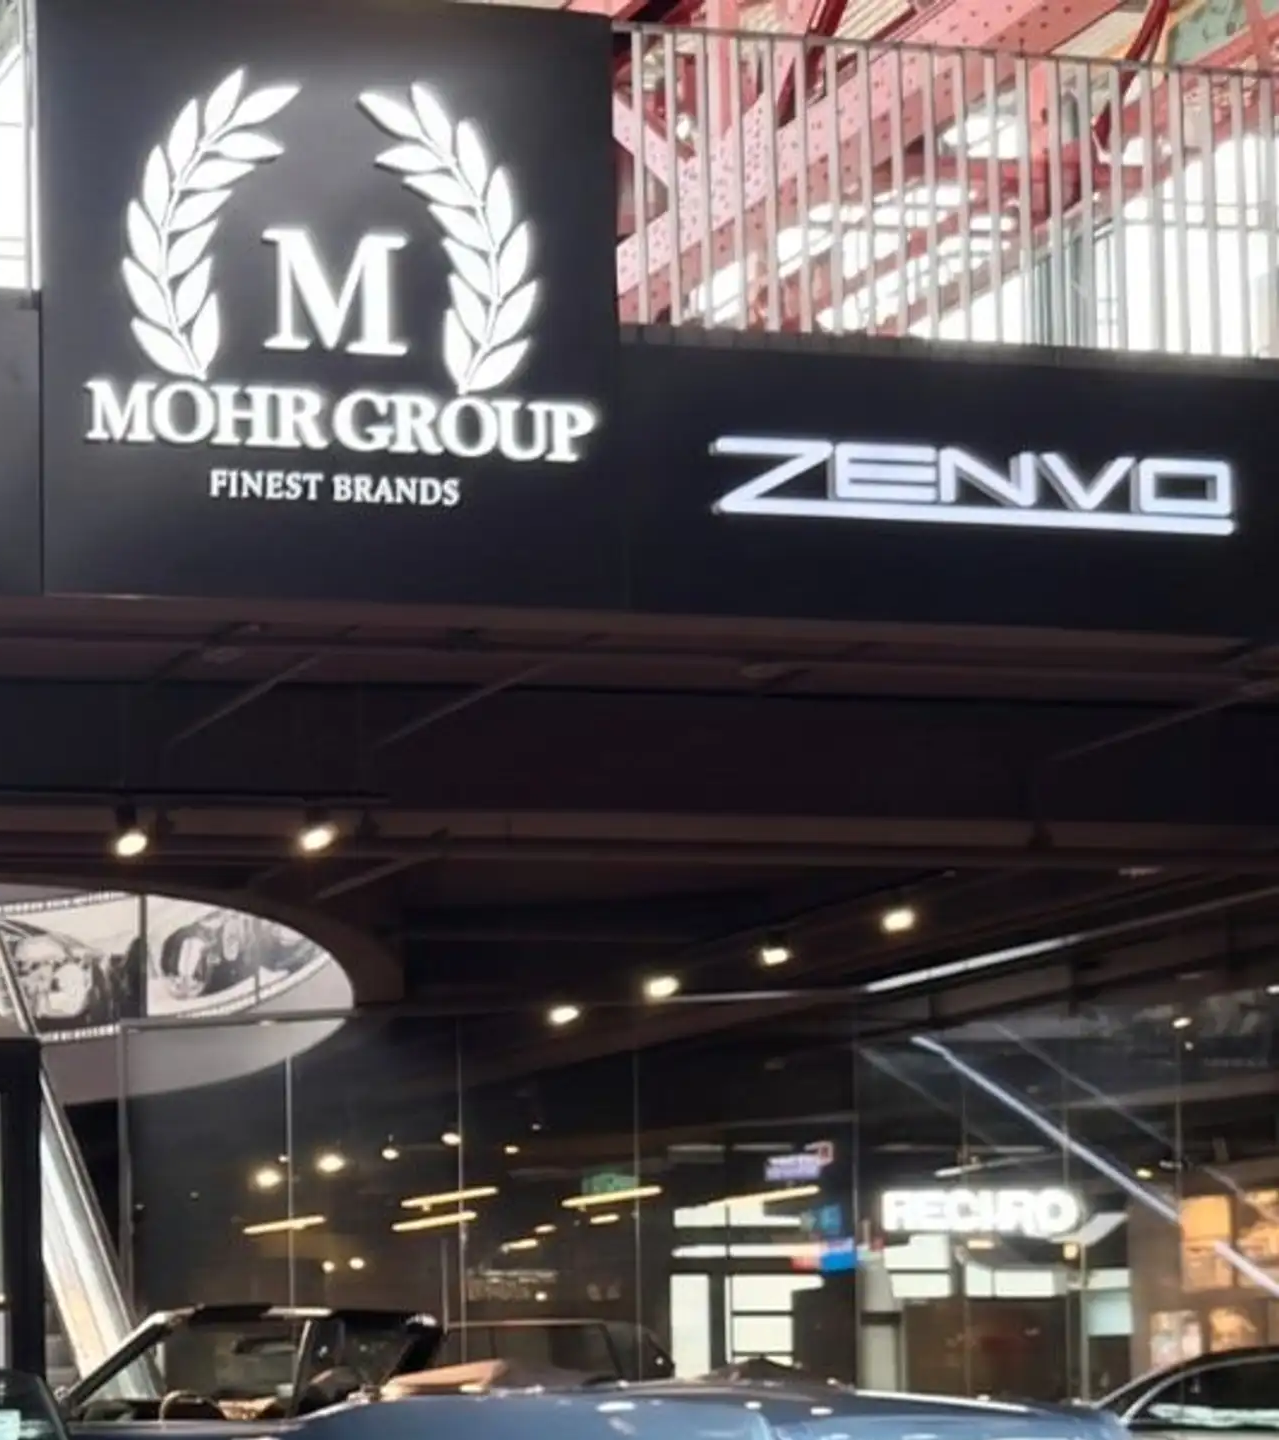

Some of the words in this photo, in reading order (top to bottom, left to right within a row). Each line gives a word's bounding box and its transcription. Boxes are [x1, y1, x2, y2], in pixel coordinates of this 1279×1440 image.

[262, 224, 409, 356] M
[85, 378, 330, 449] MOHR
[333, 389, 597, 461] GROUP
[209, 468, 325, 501] FINEST
[332, 474, 461, 506] BRANDS
[710, 437, 1237, 535] ZENVO
